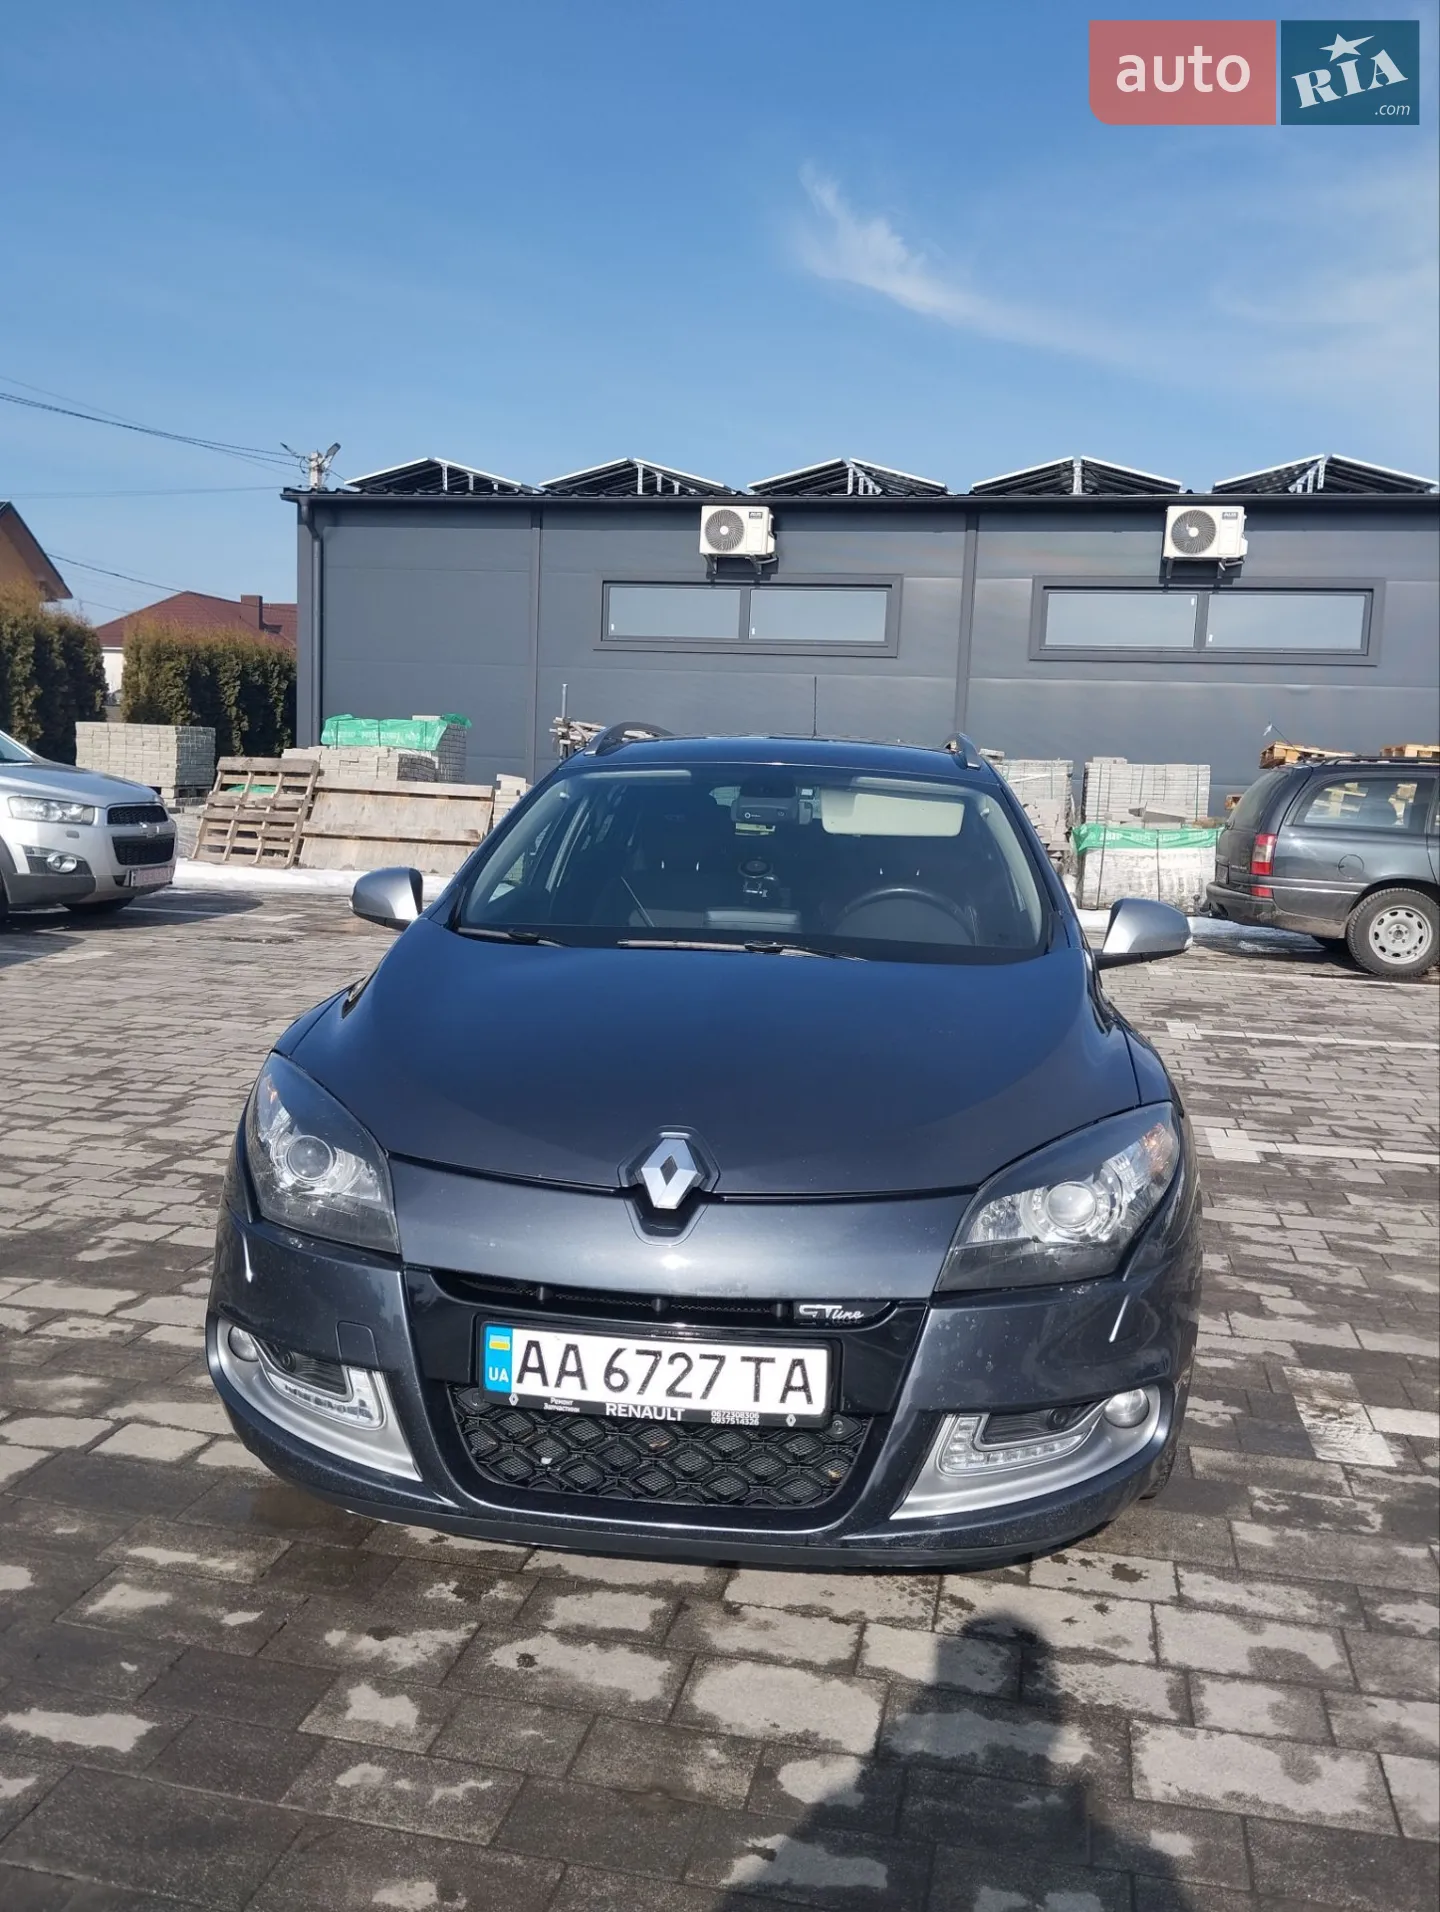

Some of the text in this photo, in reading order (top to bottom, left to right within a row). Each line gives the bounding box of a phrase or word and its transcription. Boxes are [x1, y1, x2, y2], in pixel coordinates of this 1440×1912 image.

[488, 1366, 509, 1383] UA
[516, 1339, 814, 1405] AA 6727 TA
[605, 1402, 686, 1422] RENAULT
